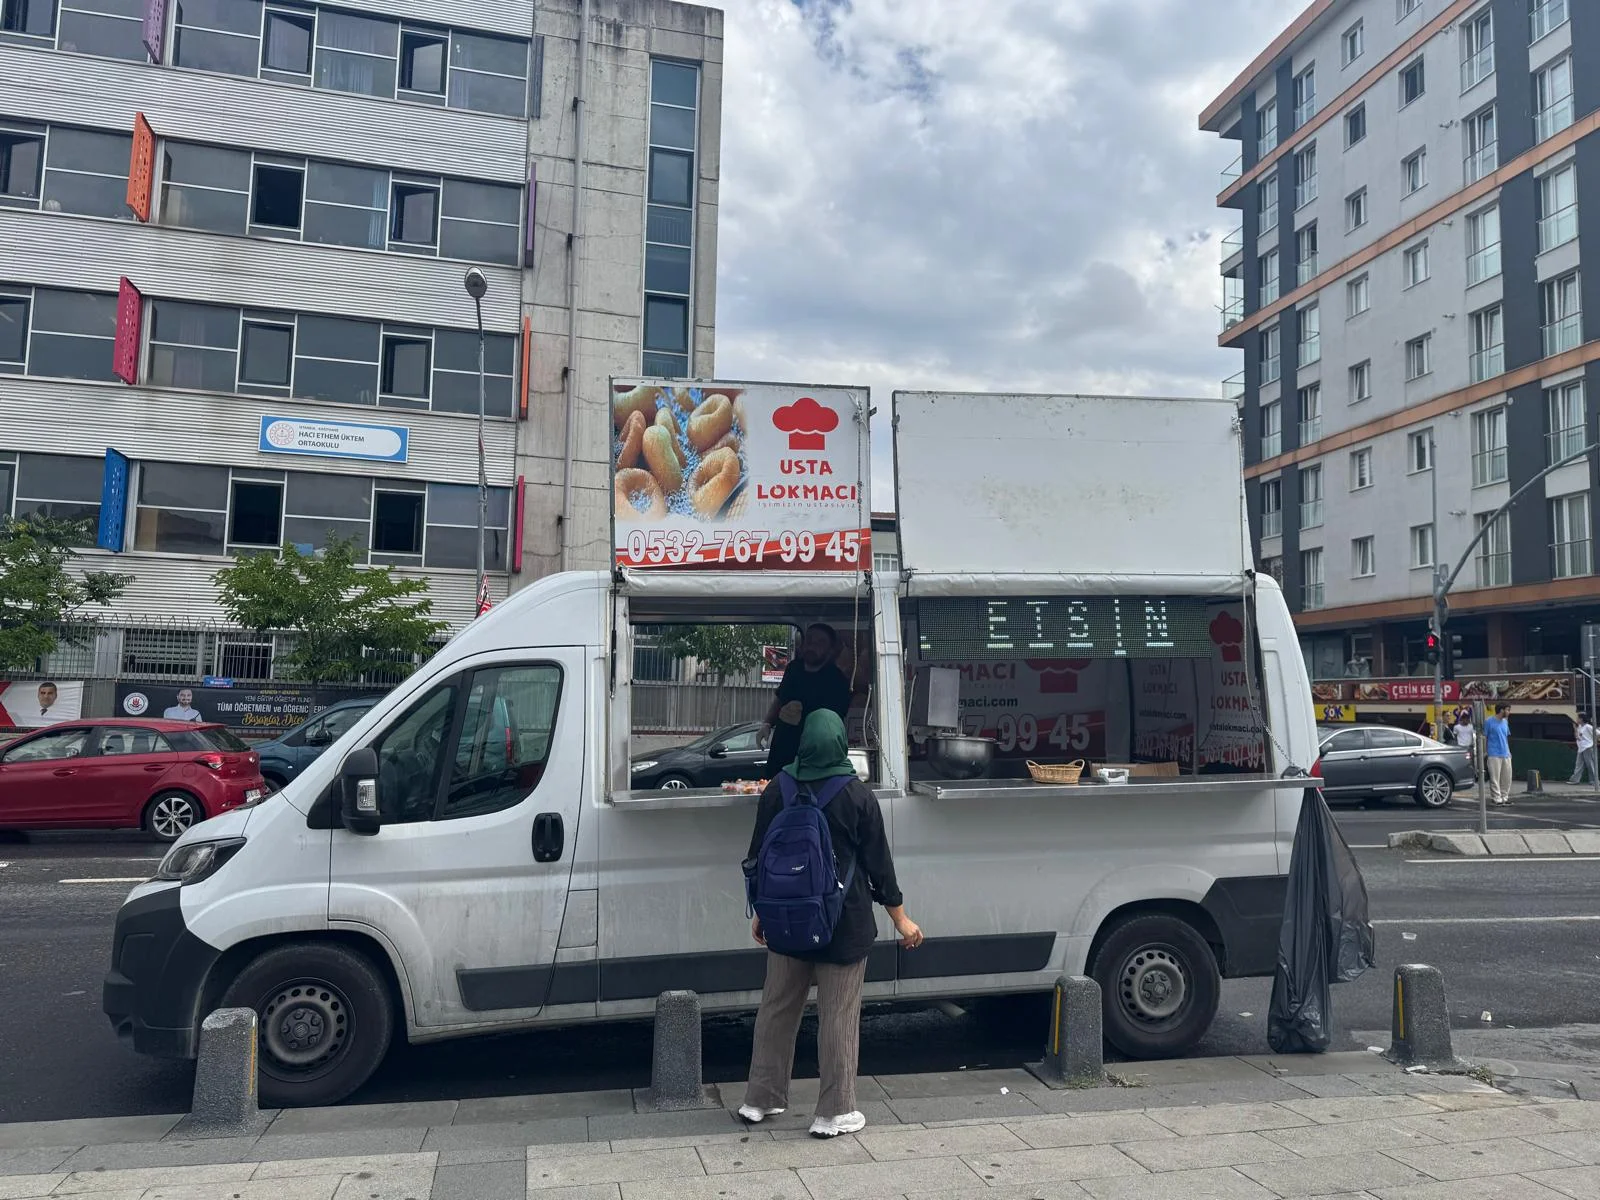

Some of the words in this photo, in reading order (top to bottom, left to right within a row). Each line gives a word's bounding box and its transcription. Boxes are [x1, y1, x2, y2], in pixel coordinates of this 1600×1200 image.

[298, 440, 339, 449] ORTAOKULU
[317, 432, 339, 440] ETHEM
[341, 433, 365, 442] ÜKTEM
[780, 459, 833, 475] USTA
[757, 484, 856, 500] LOKMACI
[627, 530, 704, 563] 0532
[714, 530, 769, 563] 767
[779, 530, 816, 562] 99
[825, 531, 859, 562] 45
[1221, 671, 1247, 687] USTA
[1392, 682, 1418, 699] ÇETİN
[217, 702, 233, 712] TÜM
[234, 702, 272, 713] ÖĞRETMEN
[1048, 713, 1090, 751] 45
